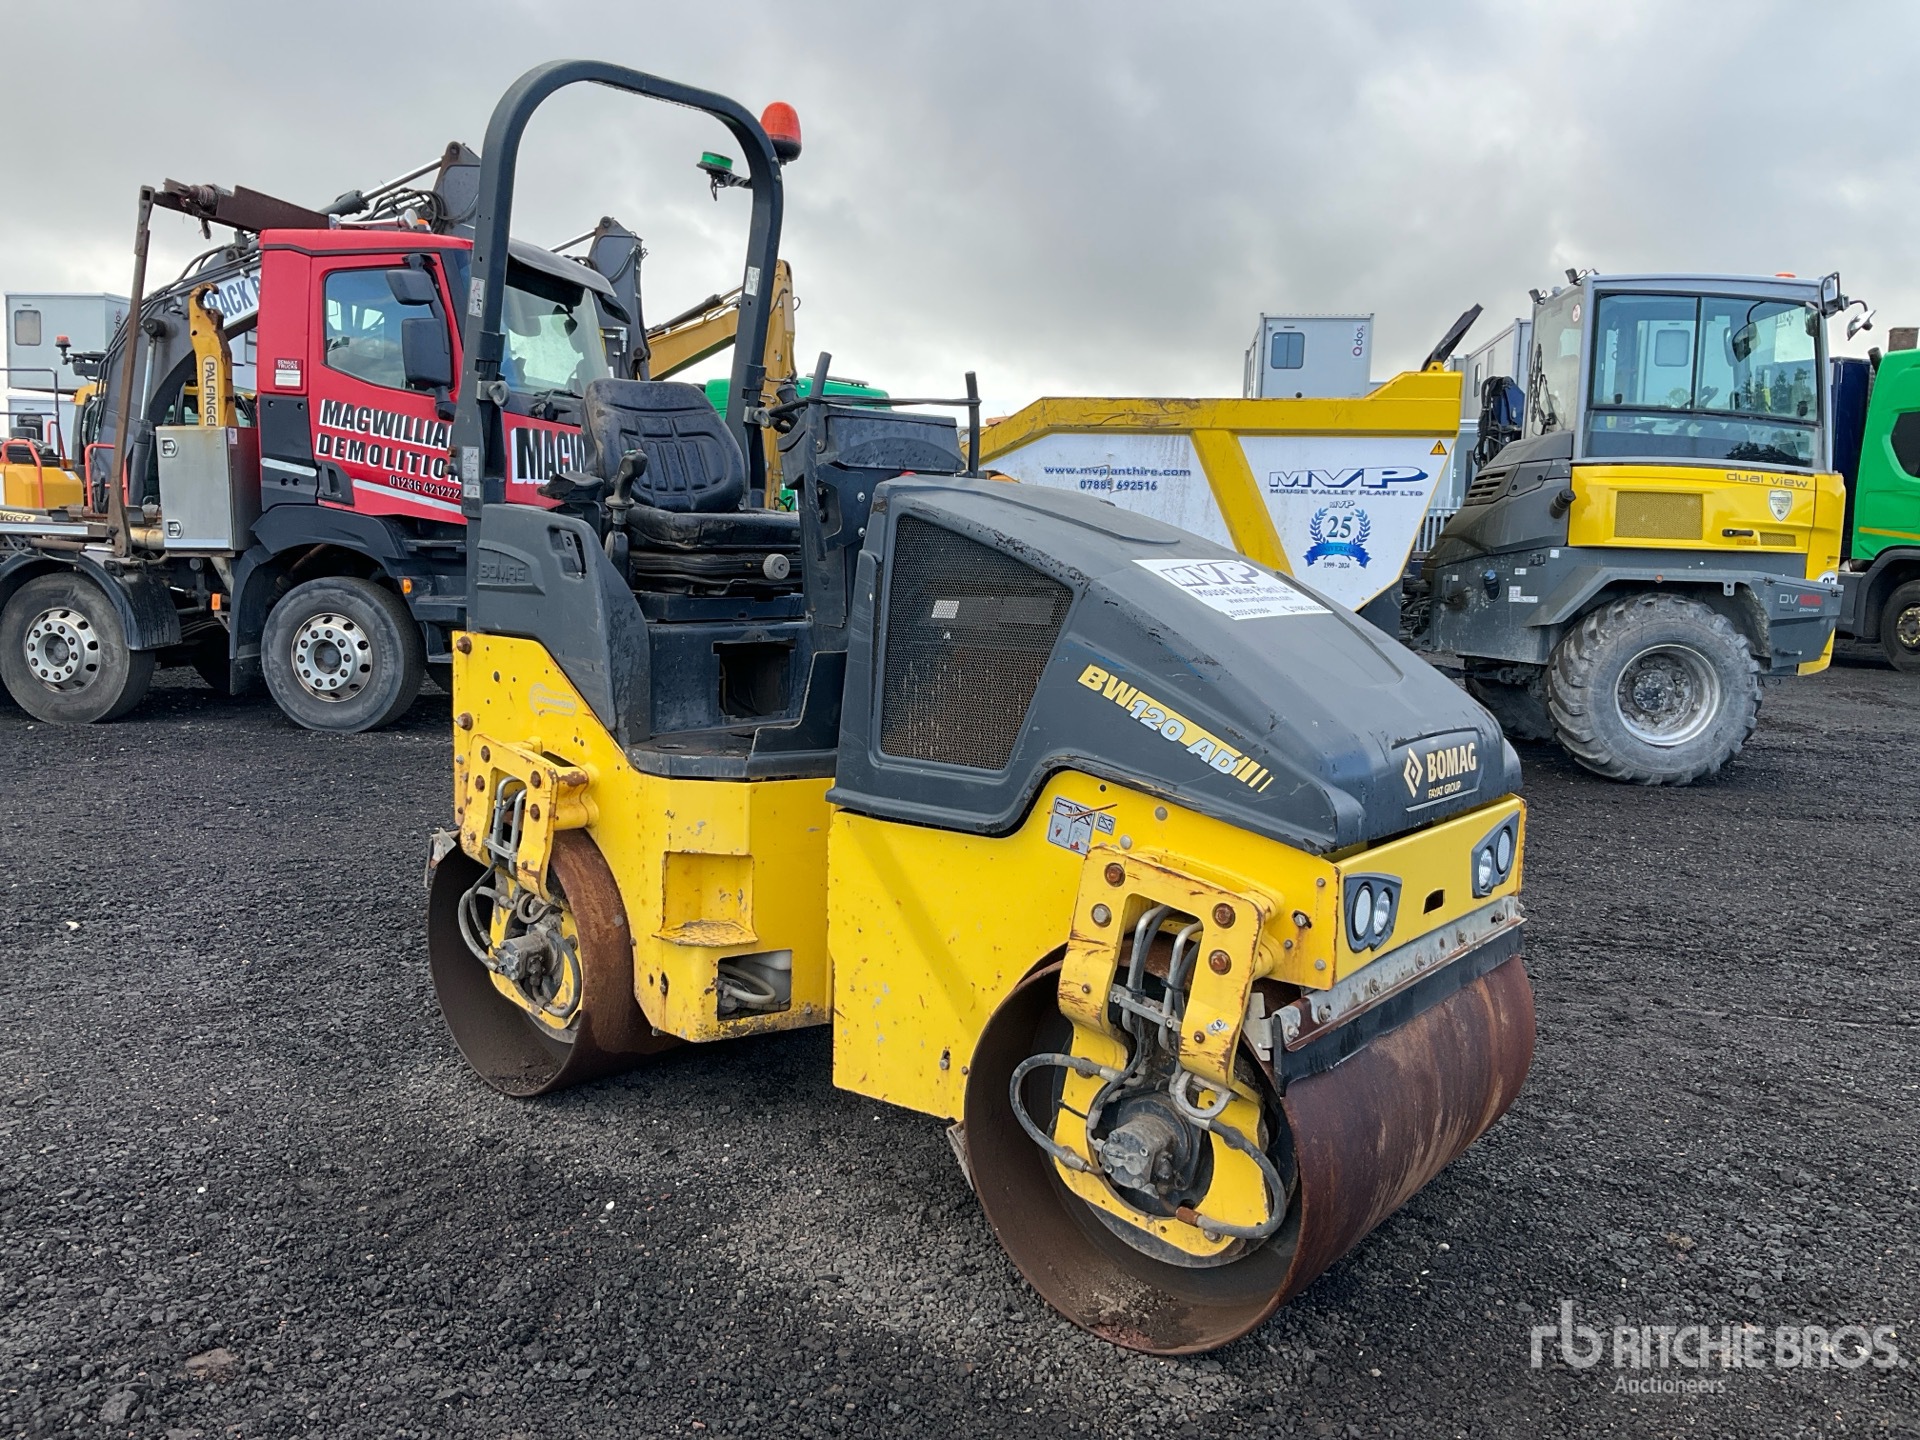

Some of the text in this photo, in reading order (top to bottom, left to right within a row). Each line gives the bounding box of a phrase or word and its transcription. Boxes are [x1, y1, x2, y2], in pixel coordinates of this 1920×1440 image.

[206, 361, 216, 426] PALFINGE
[319, 399, 453, 451] MACWILLIA
[389, 475, 422, 491] 01236
[1116, 480, 1158, 491] 692516
[1269, 466, 1428, 489] MVP
[1726, 473, 1808, 488] dual view
[1160, 561, 1260, 587] MVP
[1779, 594, 1799, 604] DV
[1426, 742, 1477, 783] BOMAG
[1428, 780, 1462, 799] FAYAT GROUP
